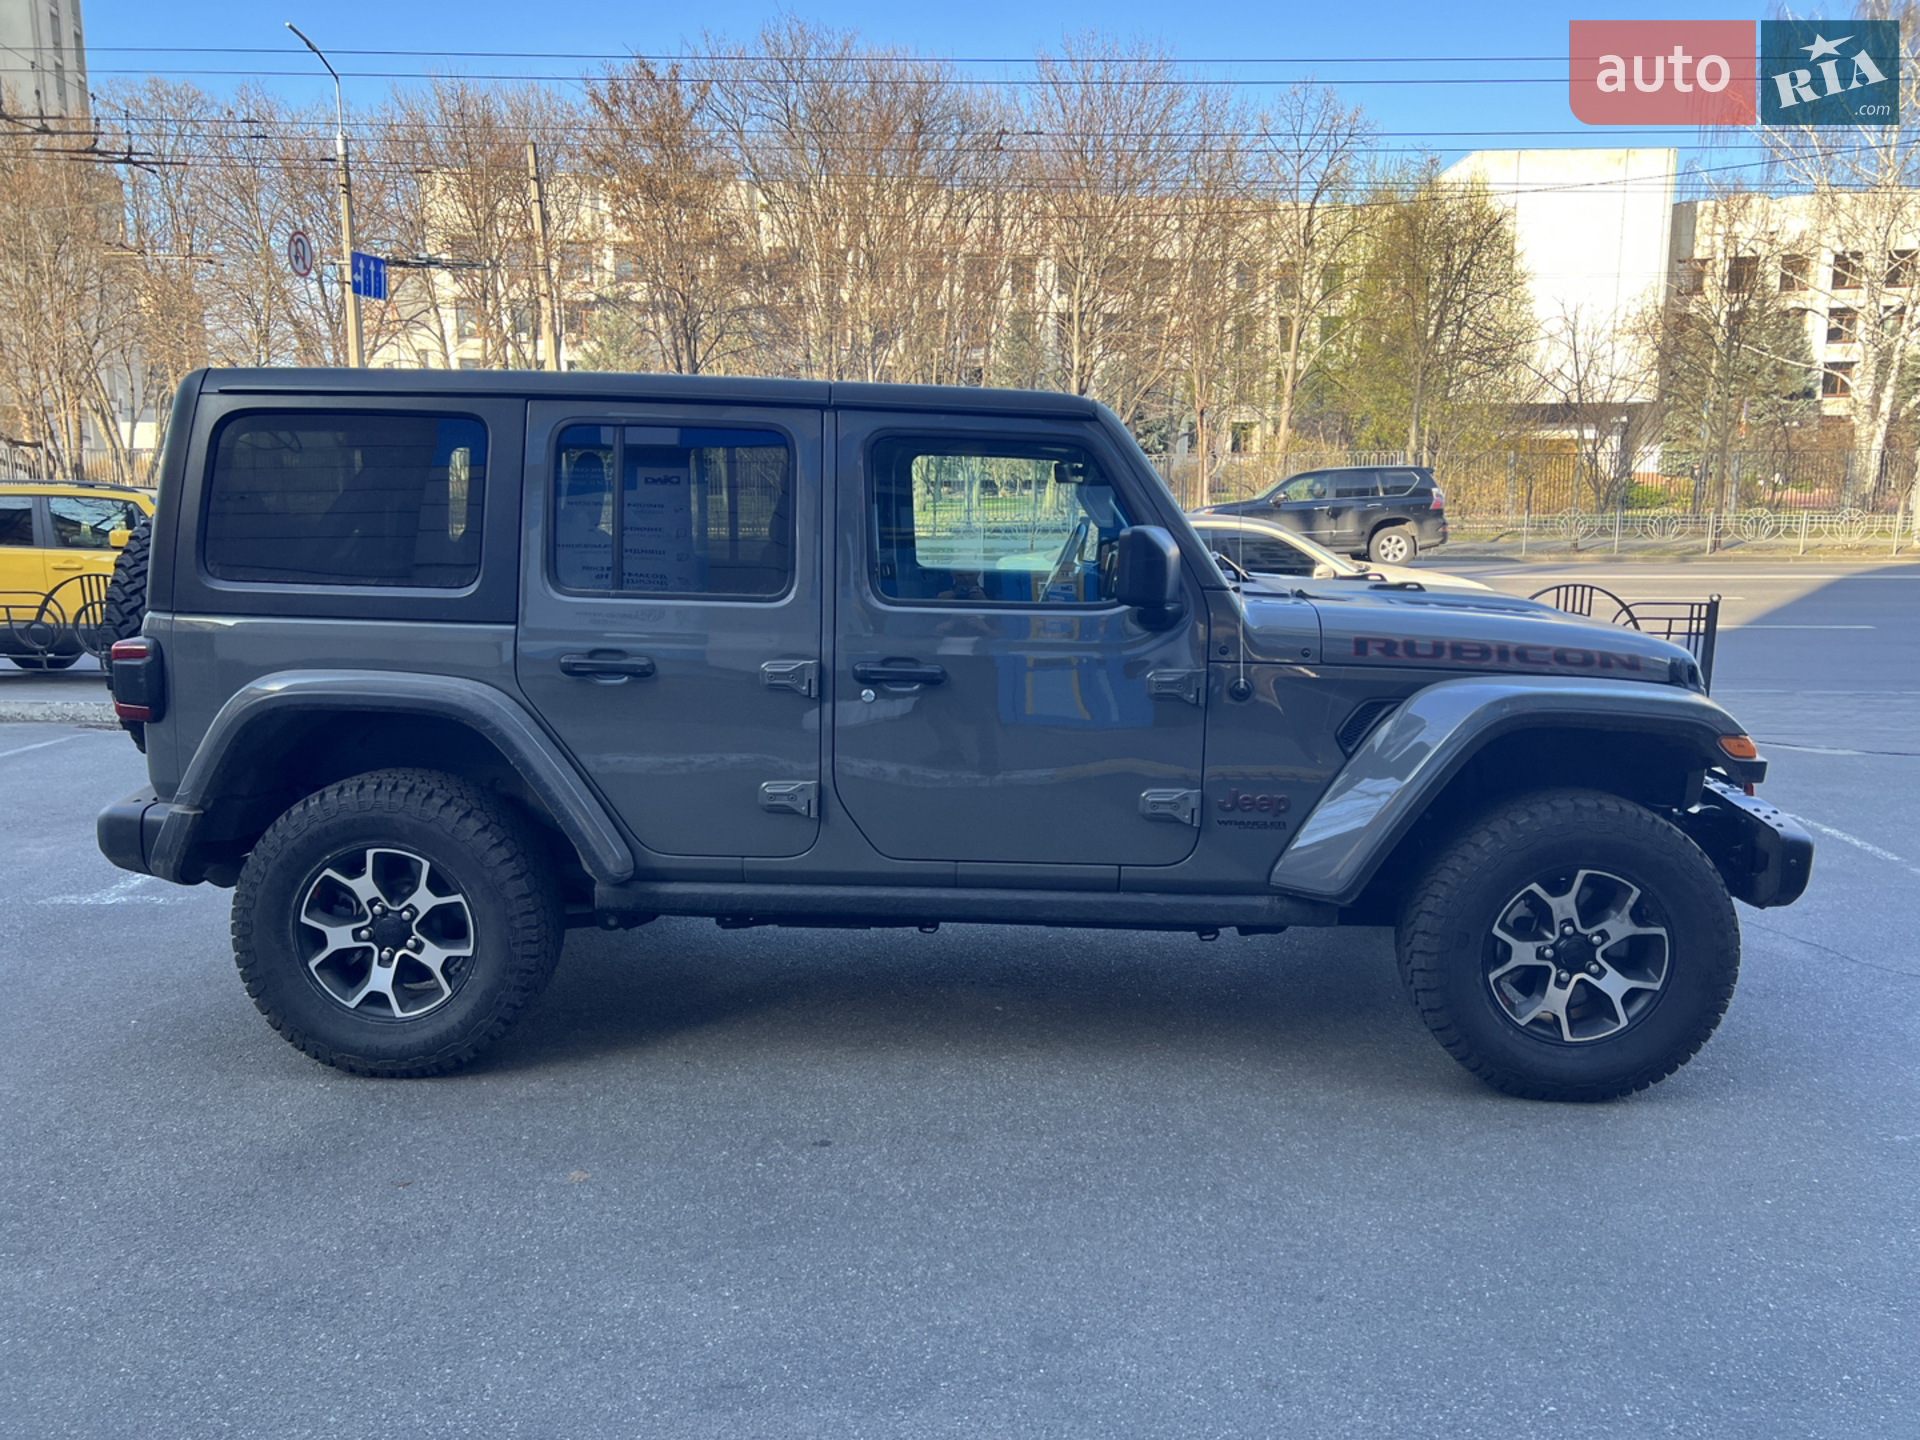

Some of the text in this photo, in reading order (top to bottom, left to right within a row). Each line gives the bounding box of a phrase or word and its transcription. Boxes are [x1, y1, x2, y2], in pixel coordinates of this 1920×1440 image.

[1353, 636, 1642, 672] RUBICON
[1217, 787, 1291, 817] Jeep
[1216, 819, 1287, 828] WRANGLER
